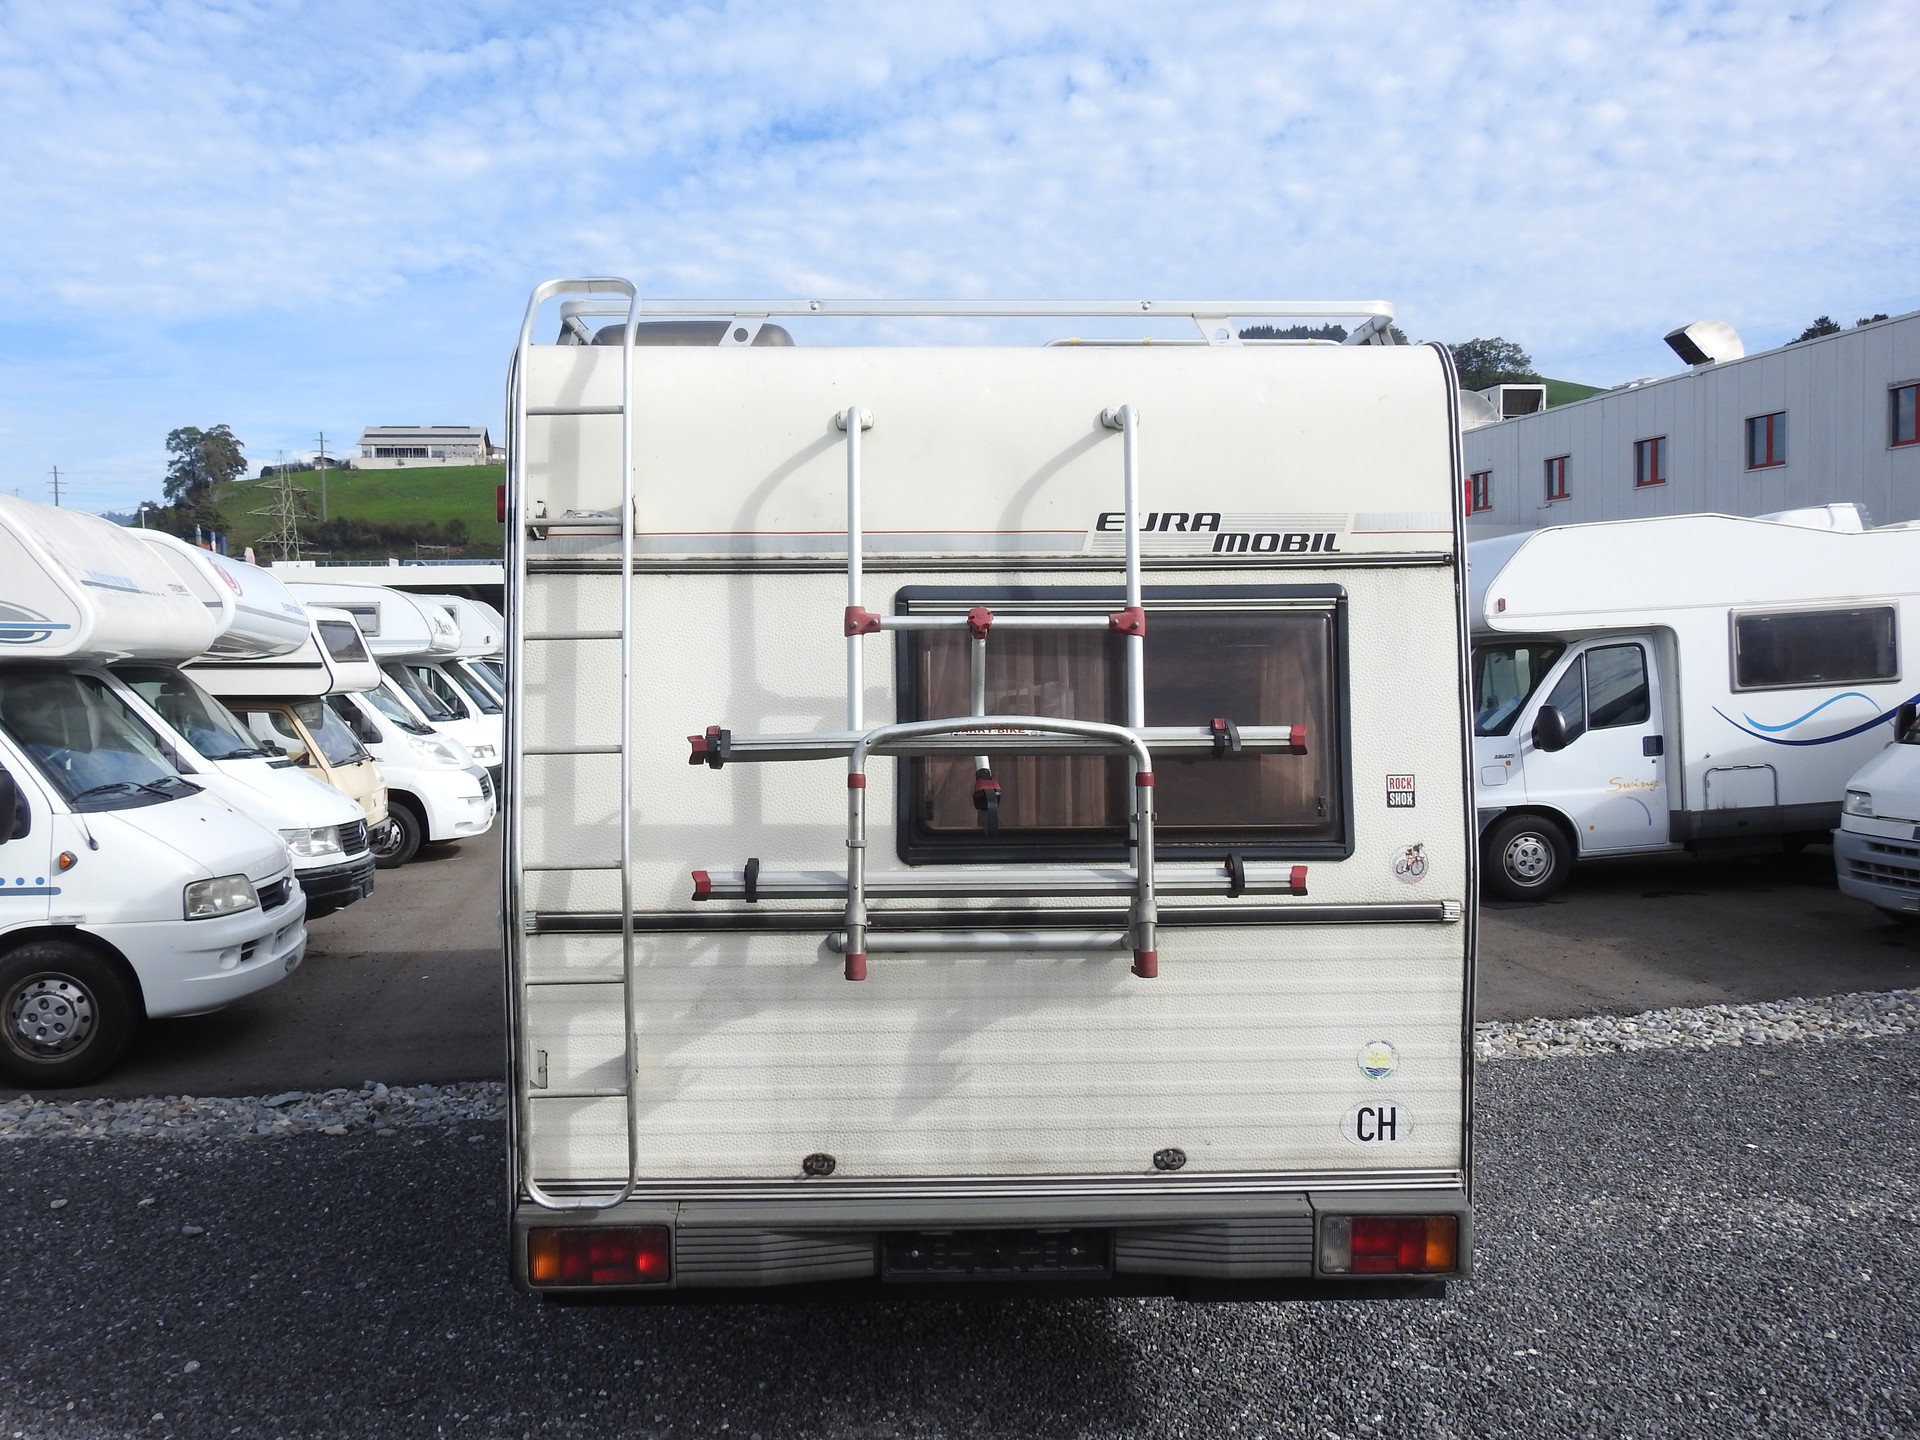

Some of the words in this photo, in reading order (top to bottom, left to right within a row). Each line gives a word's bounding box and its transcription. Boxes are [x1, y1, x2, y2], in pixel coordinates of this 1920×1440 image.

[1211, 533, 1341, 552] MOBIL
[1389, 777, 1413, 790] ROCK
[1605, 776, 1659, 792] Swing
[1389, 792, 1413, 805] SHOX
[1357, 1107, 1396, 1141] CH
